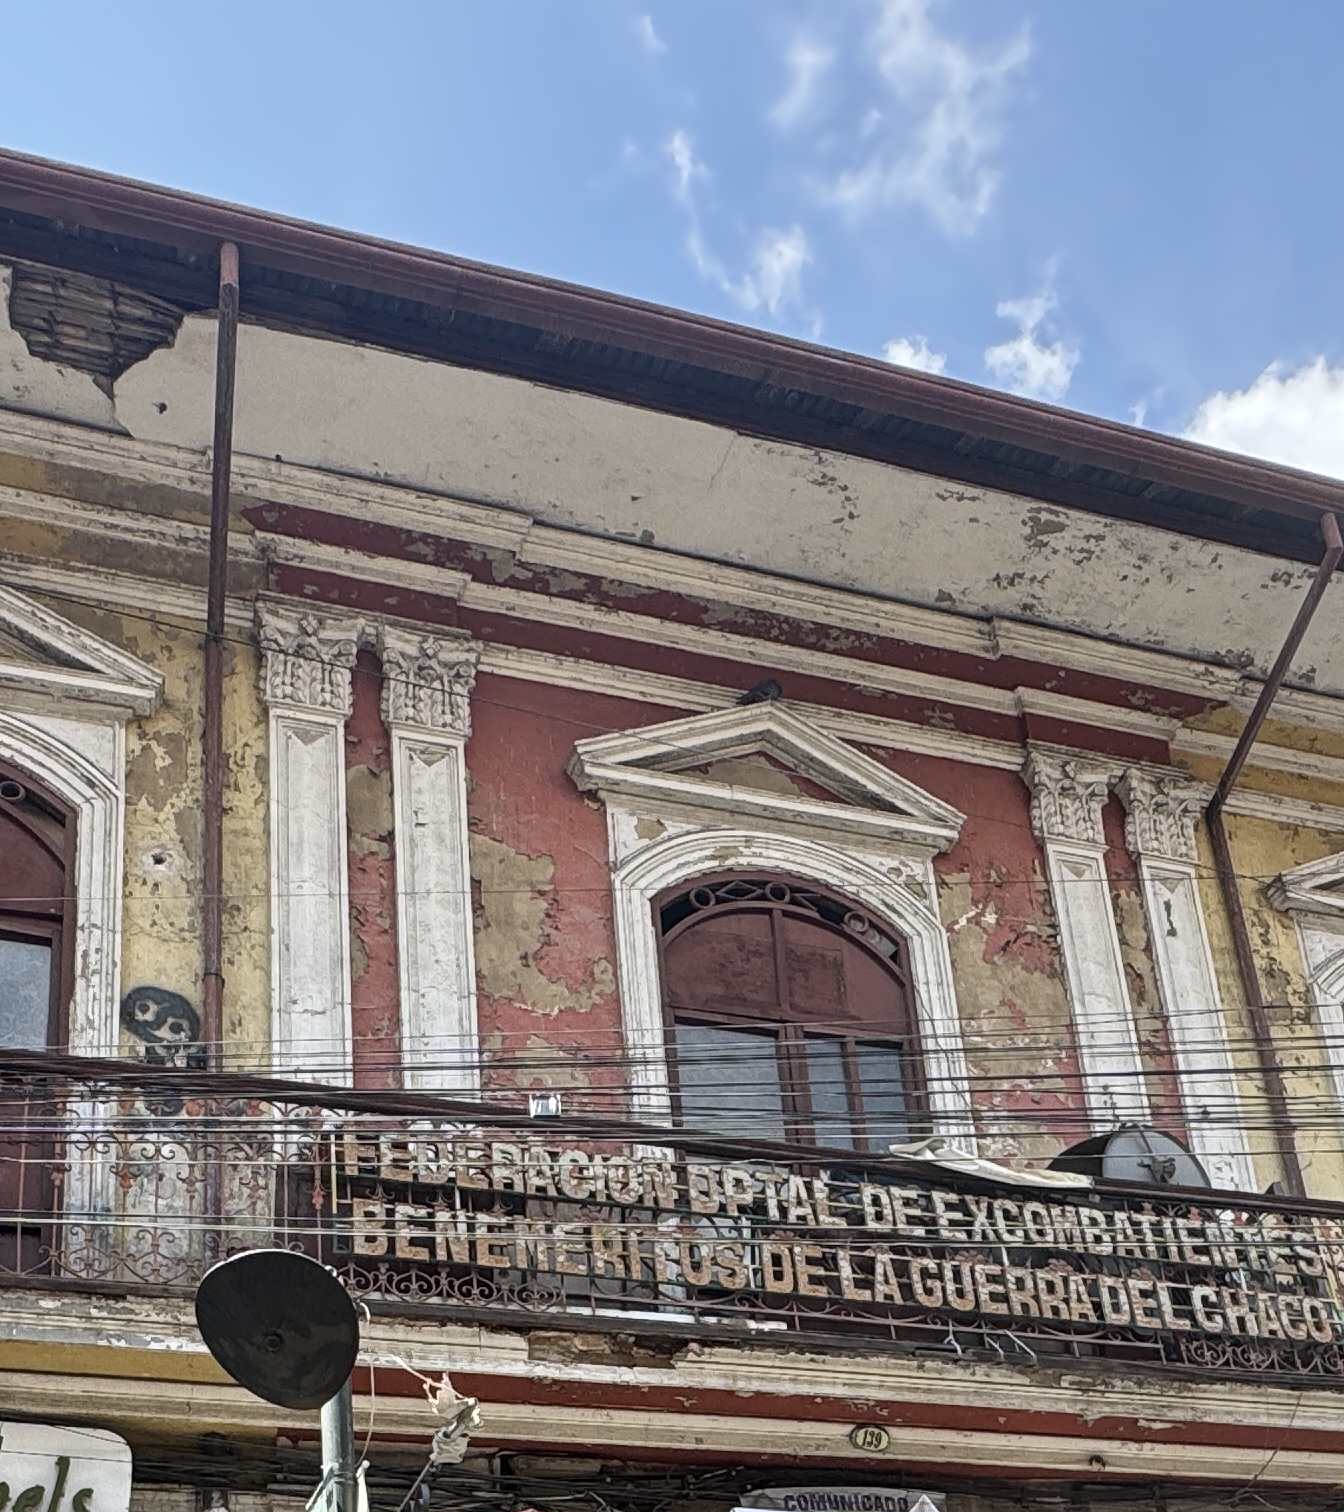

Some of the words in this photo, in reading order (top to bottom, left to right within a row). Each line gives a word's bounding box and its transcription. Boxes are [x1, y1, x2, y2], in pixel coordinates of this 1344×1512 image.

[343, 1133, 676, 1209] FEDERACION
[859, 1182, 926, 1237] DE
[353, 1198, 748, 1288] BENEMERITOS
[763, 1243, 828, 1297] DE
[838, 1245, 903, 1304] LA
[911, 1257, 1096, 1322] GUERRA
[1097, 1274, 1191, 1329] DEL
[1191, 1285, 1332, 1343] CHACO
[862, 1430, 882, 1448] 139
